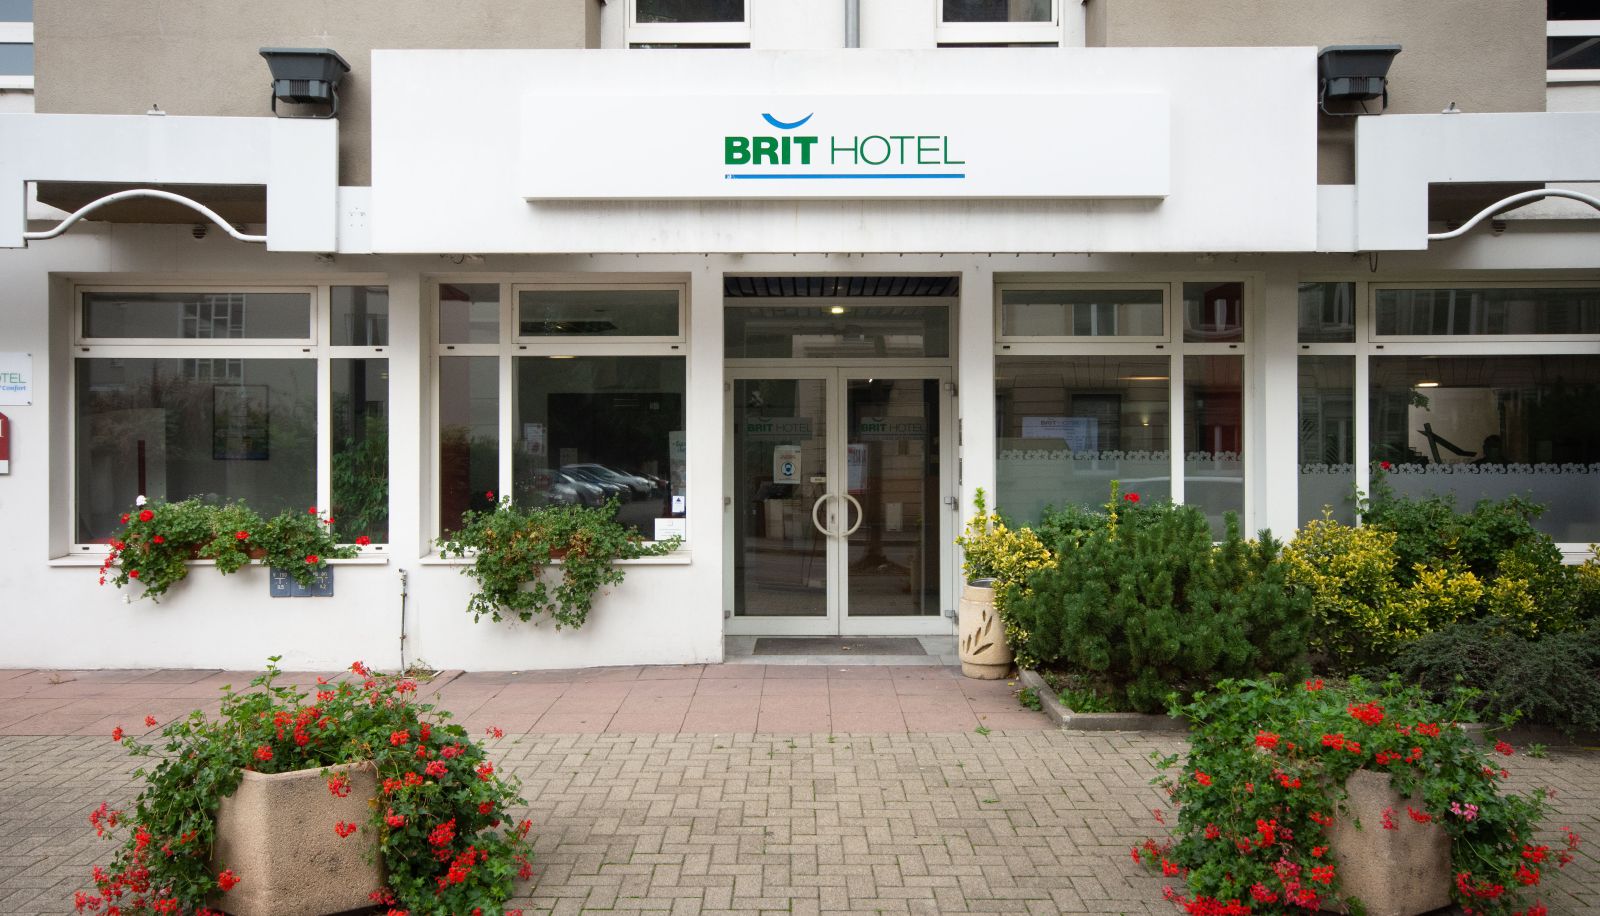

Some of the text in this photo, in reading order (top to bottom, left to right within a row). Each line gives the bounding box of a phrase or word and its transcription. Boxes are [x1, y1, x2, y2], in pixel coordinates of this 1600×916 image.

[724, 135, 966, 165] BRIT HOTEL
[0, 372, 27, 383] TEL
[747, 423, 812, 433] BRIT HOTEL
[861, 423, 926, 433] BRIT HOTEL
